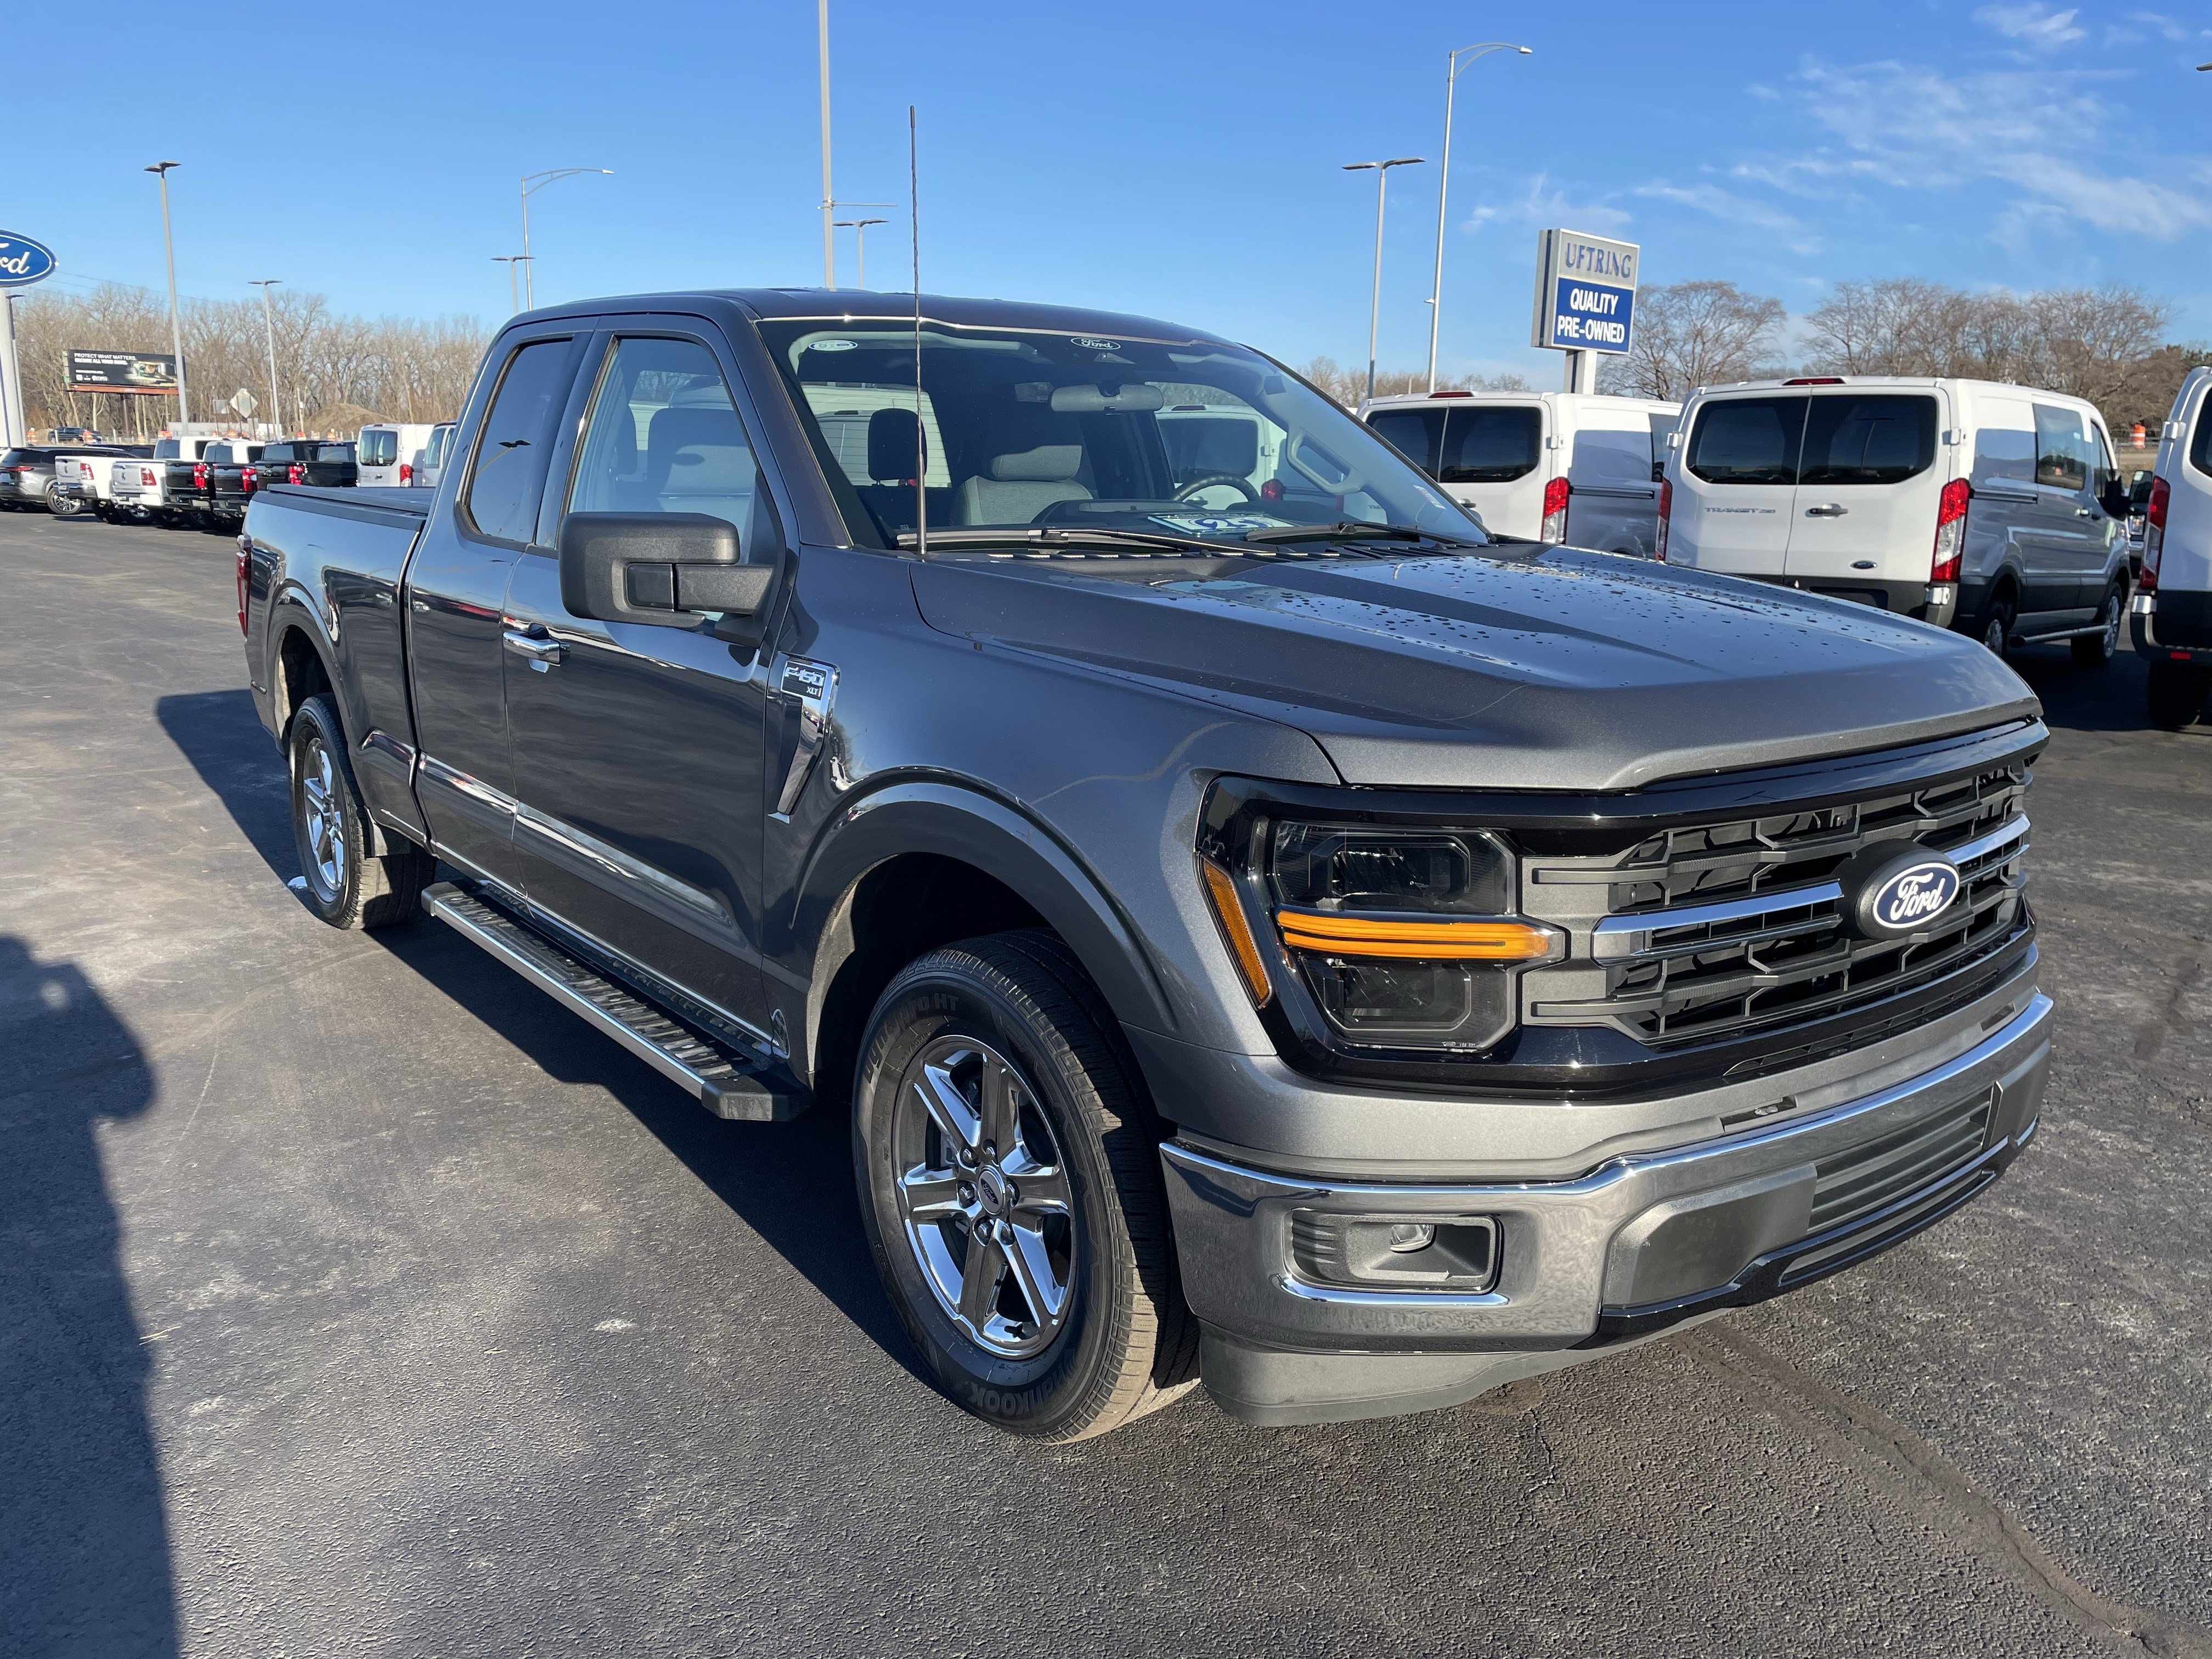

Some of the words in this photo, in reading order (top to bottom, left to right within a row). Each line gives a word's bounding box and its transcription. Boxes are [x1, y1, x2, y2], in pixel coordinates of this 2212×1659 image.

[1565, 242, 1632, 278] UFTRING
[1570, 287, 1619, 315] QUALITY
[1556, 315, 1625, 343] PRE-OWNED
[1080, 338, 1113, 348] Ford
[785, 667, 825, 686] F-150
[806, 686, 819, 696] XLT
[1890, 872, 1946, 921] Ford
[934, 993, 959, 1012] HT
